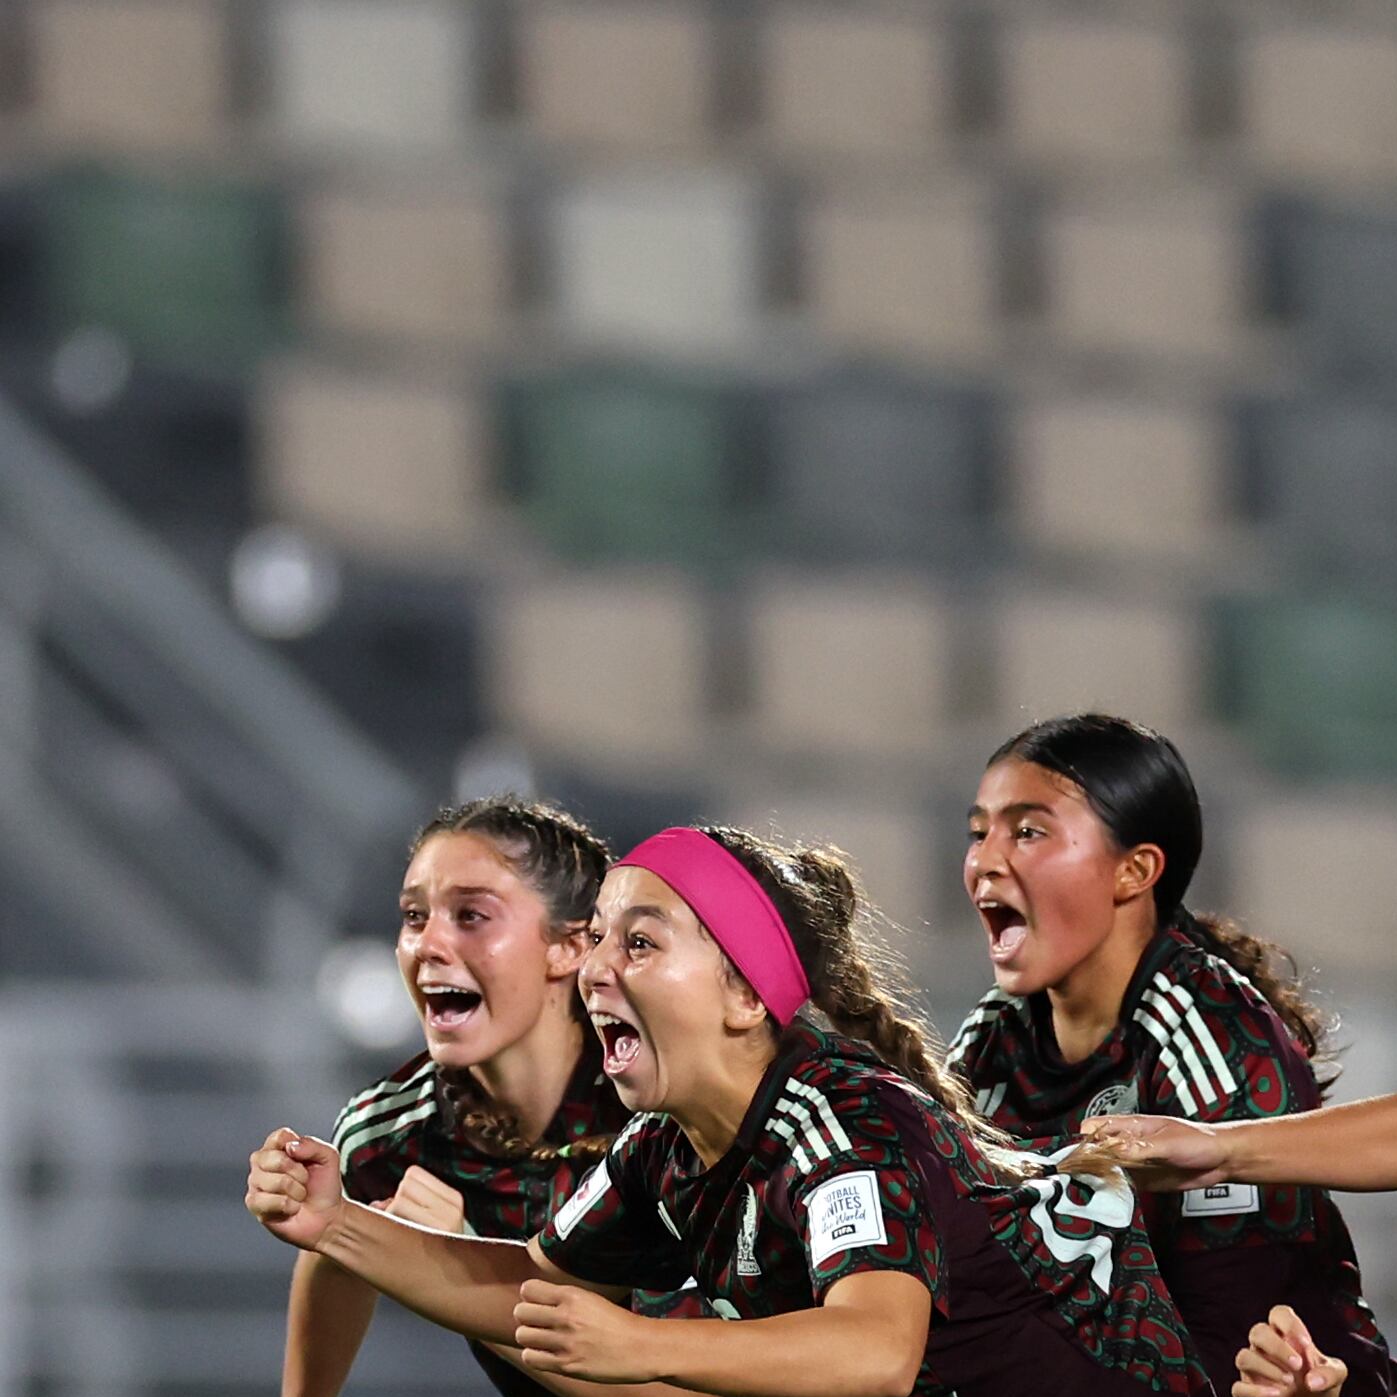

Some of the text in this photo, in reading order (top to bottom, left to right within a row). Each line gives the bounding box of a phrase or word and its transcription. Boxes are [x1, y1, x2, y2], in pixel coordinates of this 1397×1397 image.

[824, 1185, 860, 1204] OTBALL
[1206, 1187, 1228, 1197] FIFA
[833, 1225, 855, 1239] FIFA
